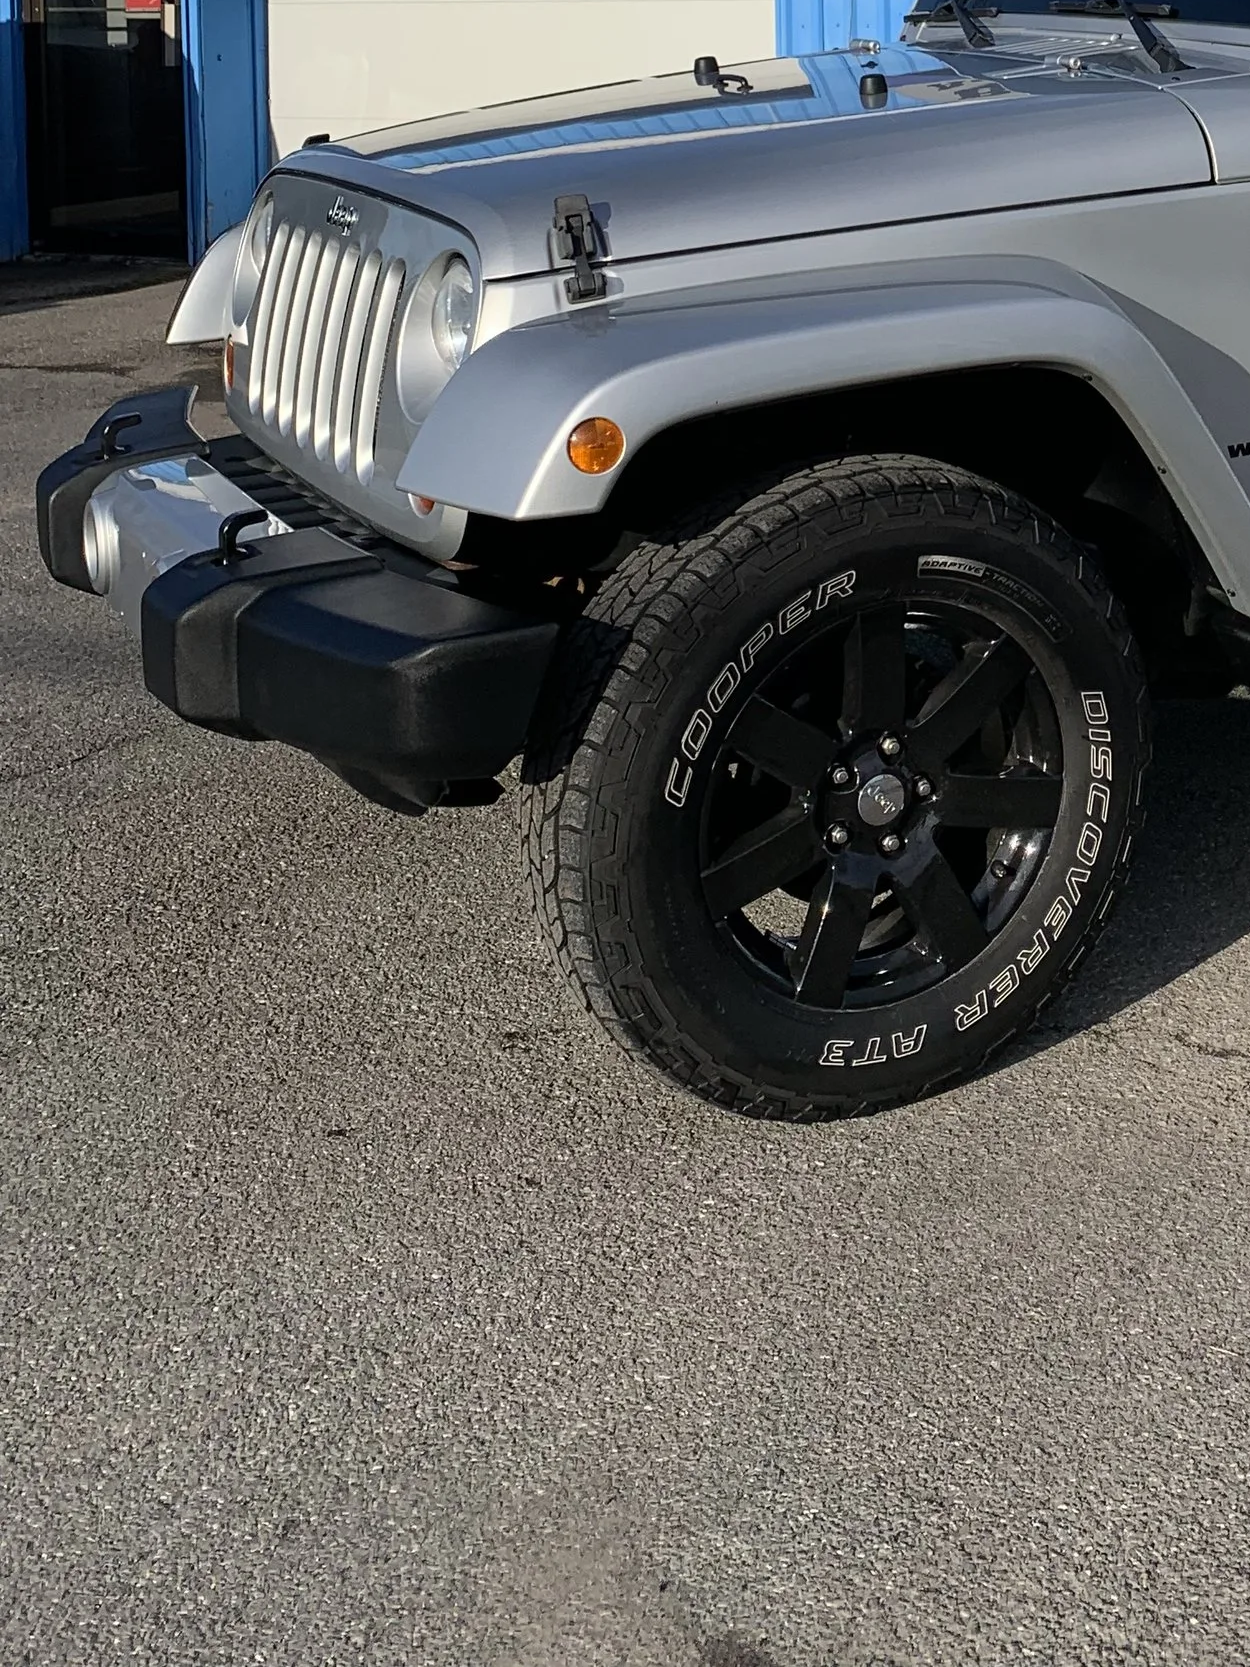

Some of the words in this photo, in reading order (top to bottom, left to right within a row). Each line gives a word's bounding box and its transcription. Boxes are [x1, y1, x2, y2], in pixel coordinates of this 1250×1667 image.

[665, 570, 856, 807] COOPER
[954, 691, 1113, 1031] DISCOVERER
[819, 1024, 928, 1067] AT3
